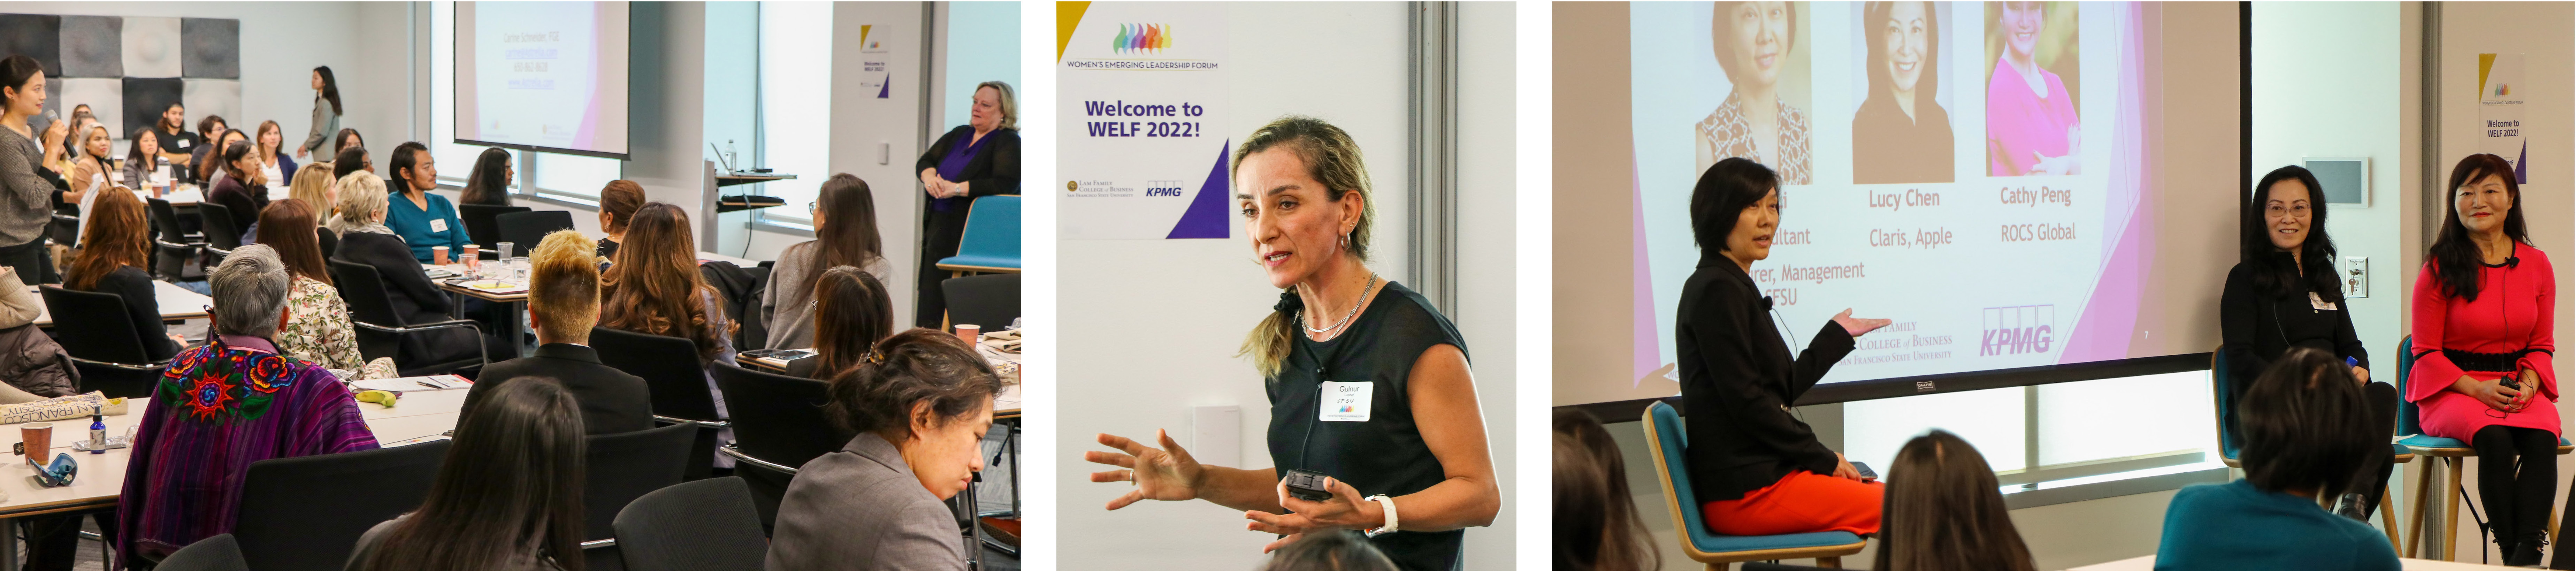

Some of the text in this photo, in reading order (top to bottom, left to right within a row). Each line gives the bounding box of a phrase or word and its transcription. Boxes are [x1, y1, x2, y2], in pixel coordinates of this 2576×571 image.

[1085, 100, 1203, 116] Welcome to
[1087, 122, 1199, 137] WELF 2022!
[1146, 187, 1181, 196] KPMG
[1870, 189, 1940, 211] Lucy Chen
[2001, 186, 2071, 207] Cathy Peng
[1772, 227, 1811, 245] ultant
[1870, 227, 1952, 249] Claris, Apple
[2001, 222, 2076, 242] ROCS Global
[1782, 262, 1865, 284] Management
[1859, 334, 1952, 350] COLLEGE of BUSINESS
[1980, 325, 2051, 357] KPMG
[2145, 330, 2148, 339] 7
[1854, 355, 1890, 365] FRANCISCO
[1892, 352, 1911, 362] STATE
[1913, 351, 1952, 360] UNIVERSITY
[5, 407, 74, 424] FRANCISCO
